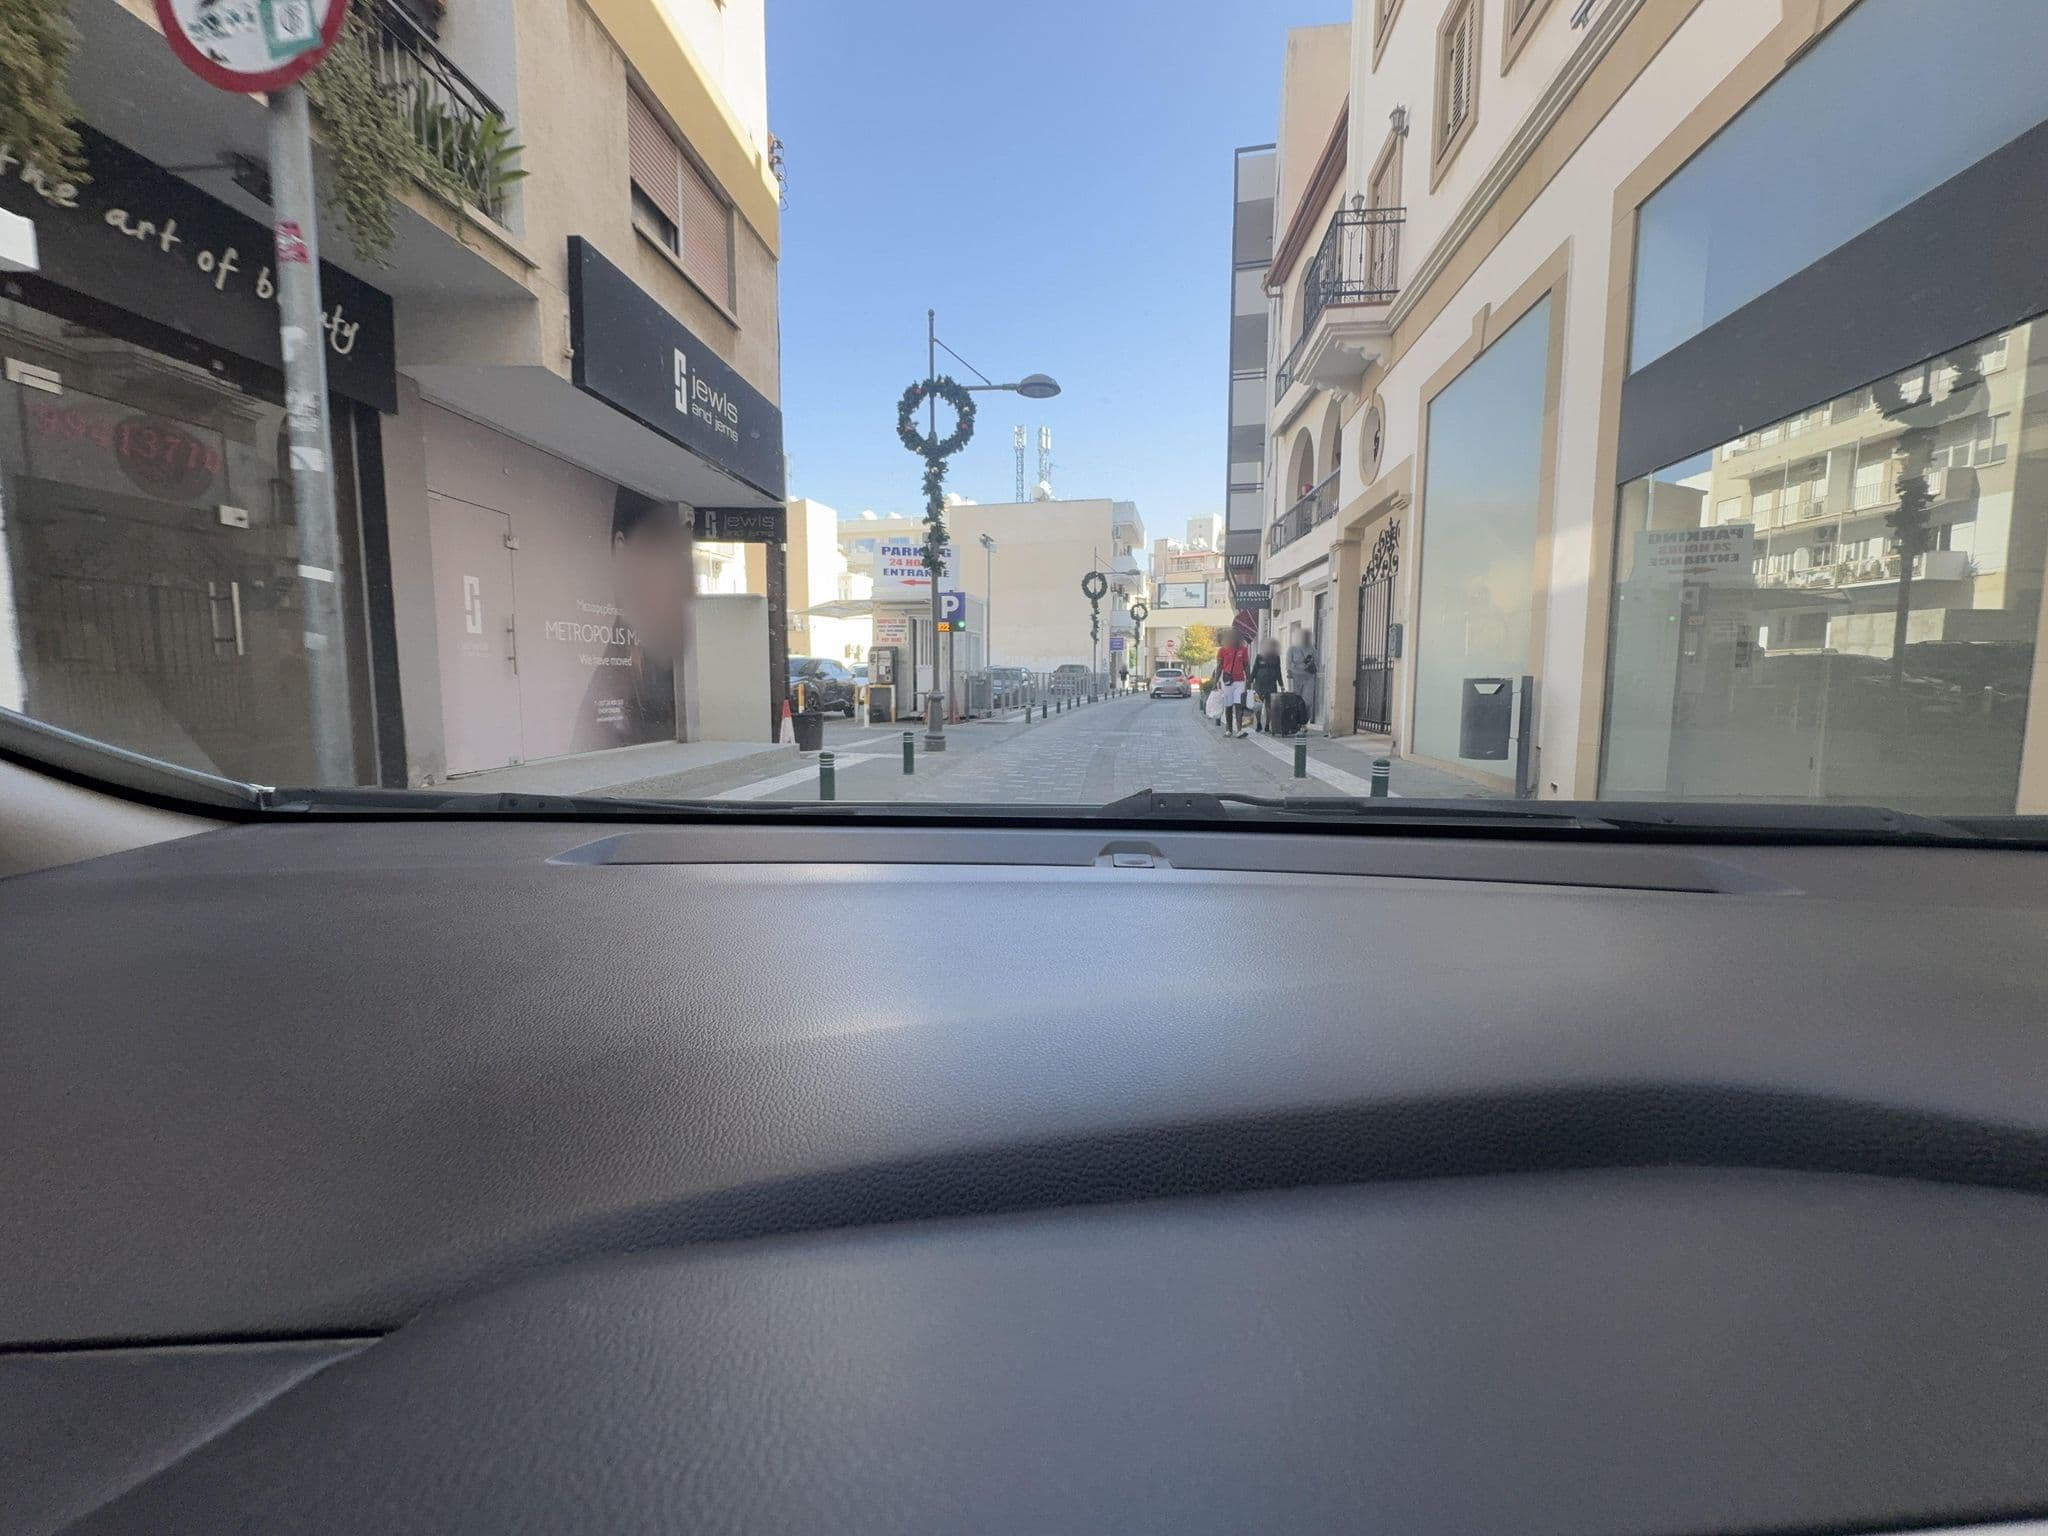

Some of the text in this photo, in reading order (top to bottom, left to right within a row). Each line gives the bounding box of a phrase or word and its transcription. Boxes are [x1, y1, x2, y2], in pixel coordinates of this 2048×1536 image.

[104, 208, 181, 253] art
[197, 247, 239, 291] of
[692, 367, 738, 424] jewls
[691, 403, 712, 425] and
[881, 546, 952, 557] PARKG
[889, 558, 902, 567] 24
[883, 567, 950, 578] ENTRANE
[940, 595, 960, 619] P
[545, 620, 626, 645] METROPOLIS
[611, 656, 632, 667] moved
